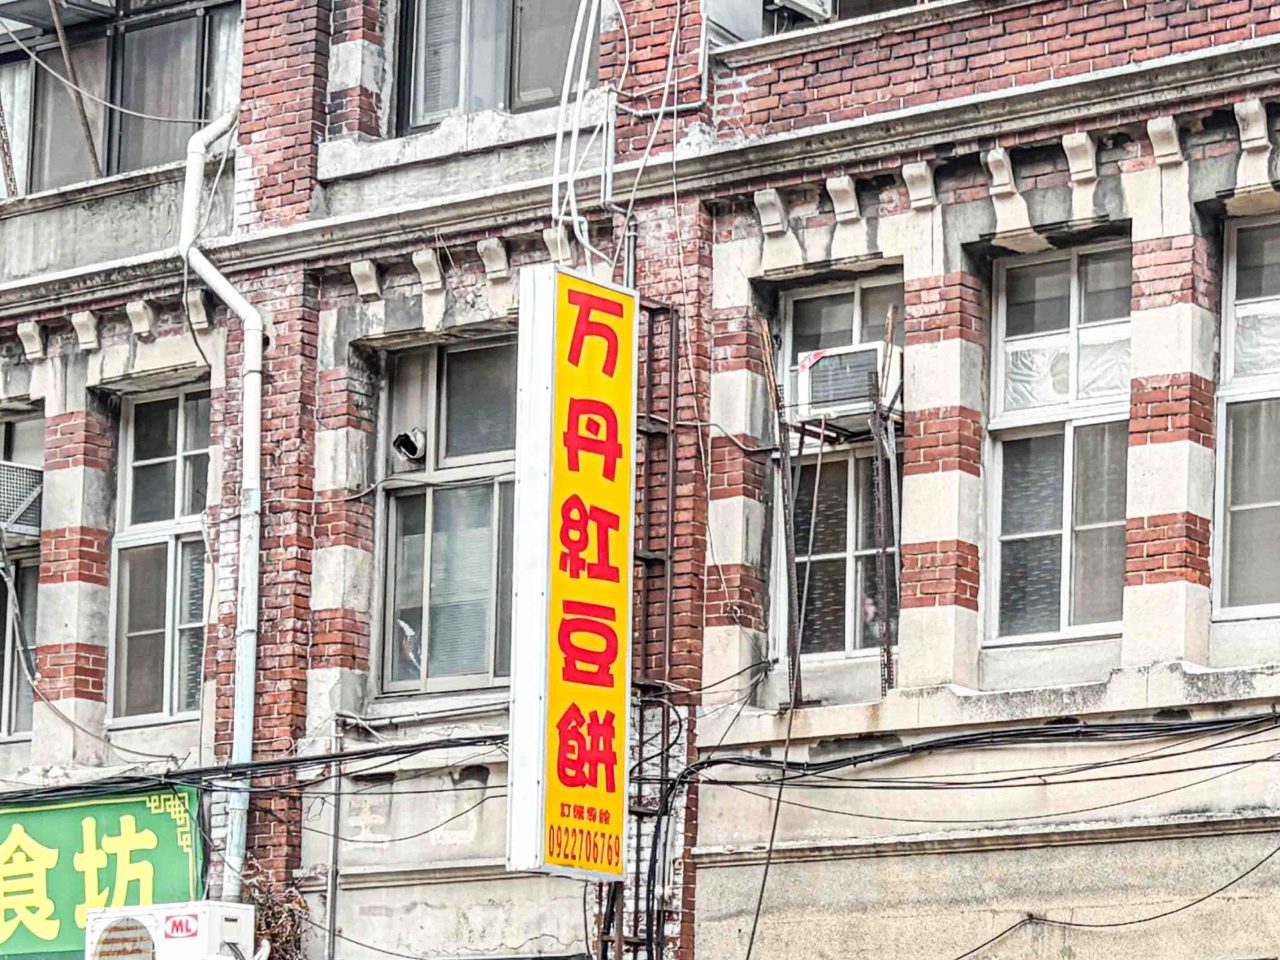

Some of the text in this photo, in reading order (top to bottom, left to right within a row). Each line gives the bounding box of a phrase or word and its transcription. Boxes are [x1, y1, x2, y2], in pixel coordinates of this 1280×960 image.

[556, 288, 624, 793] 万丹紅豆餅
[0, 814, 158, 946] 食坊
[548, 825, 621, 867] 0922706769
[171, 919, 193, 935] ML
